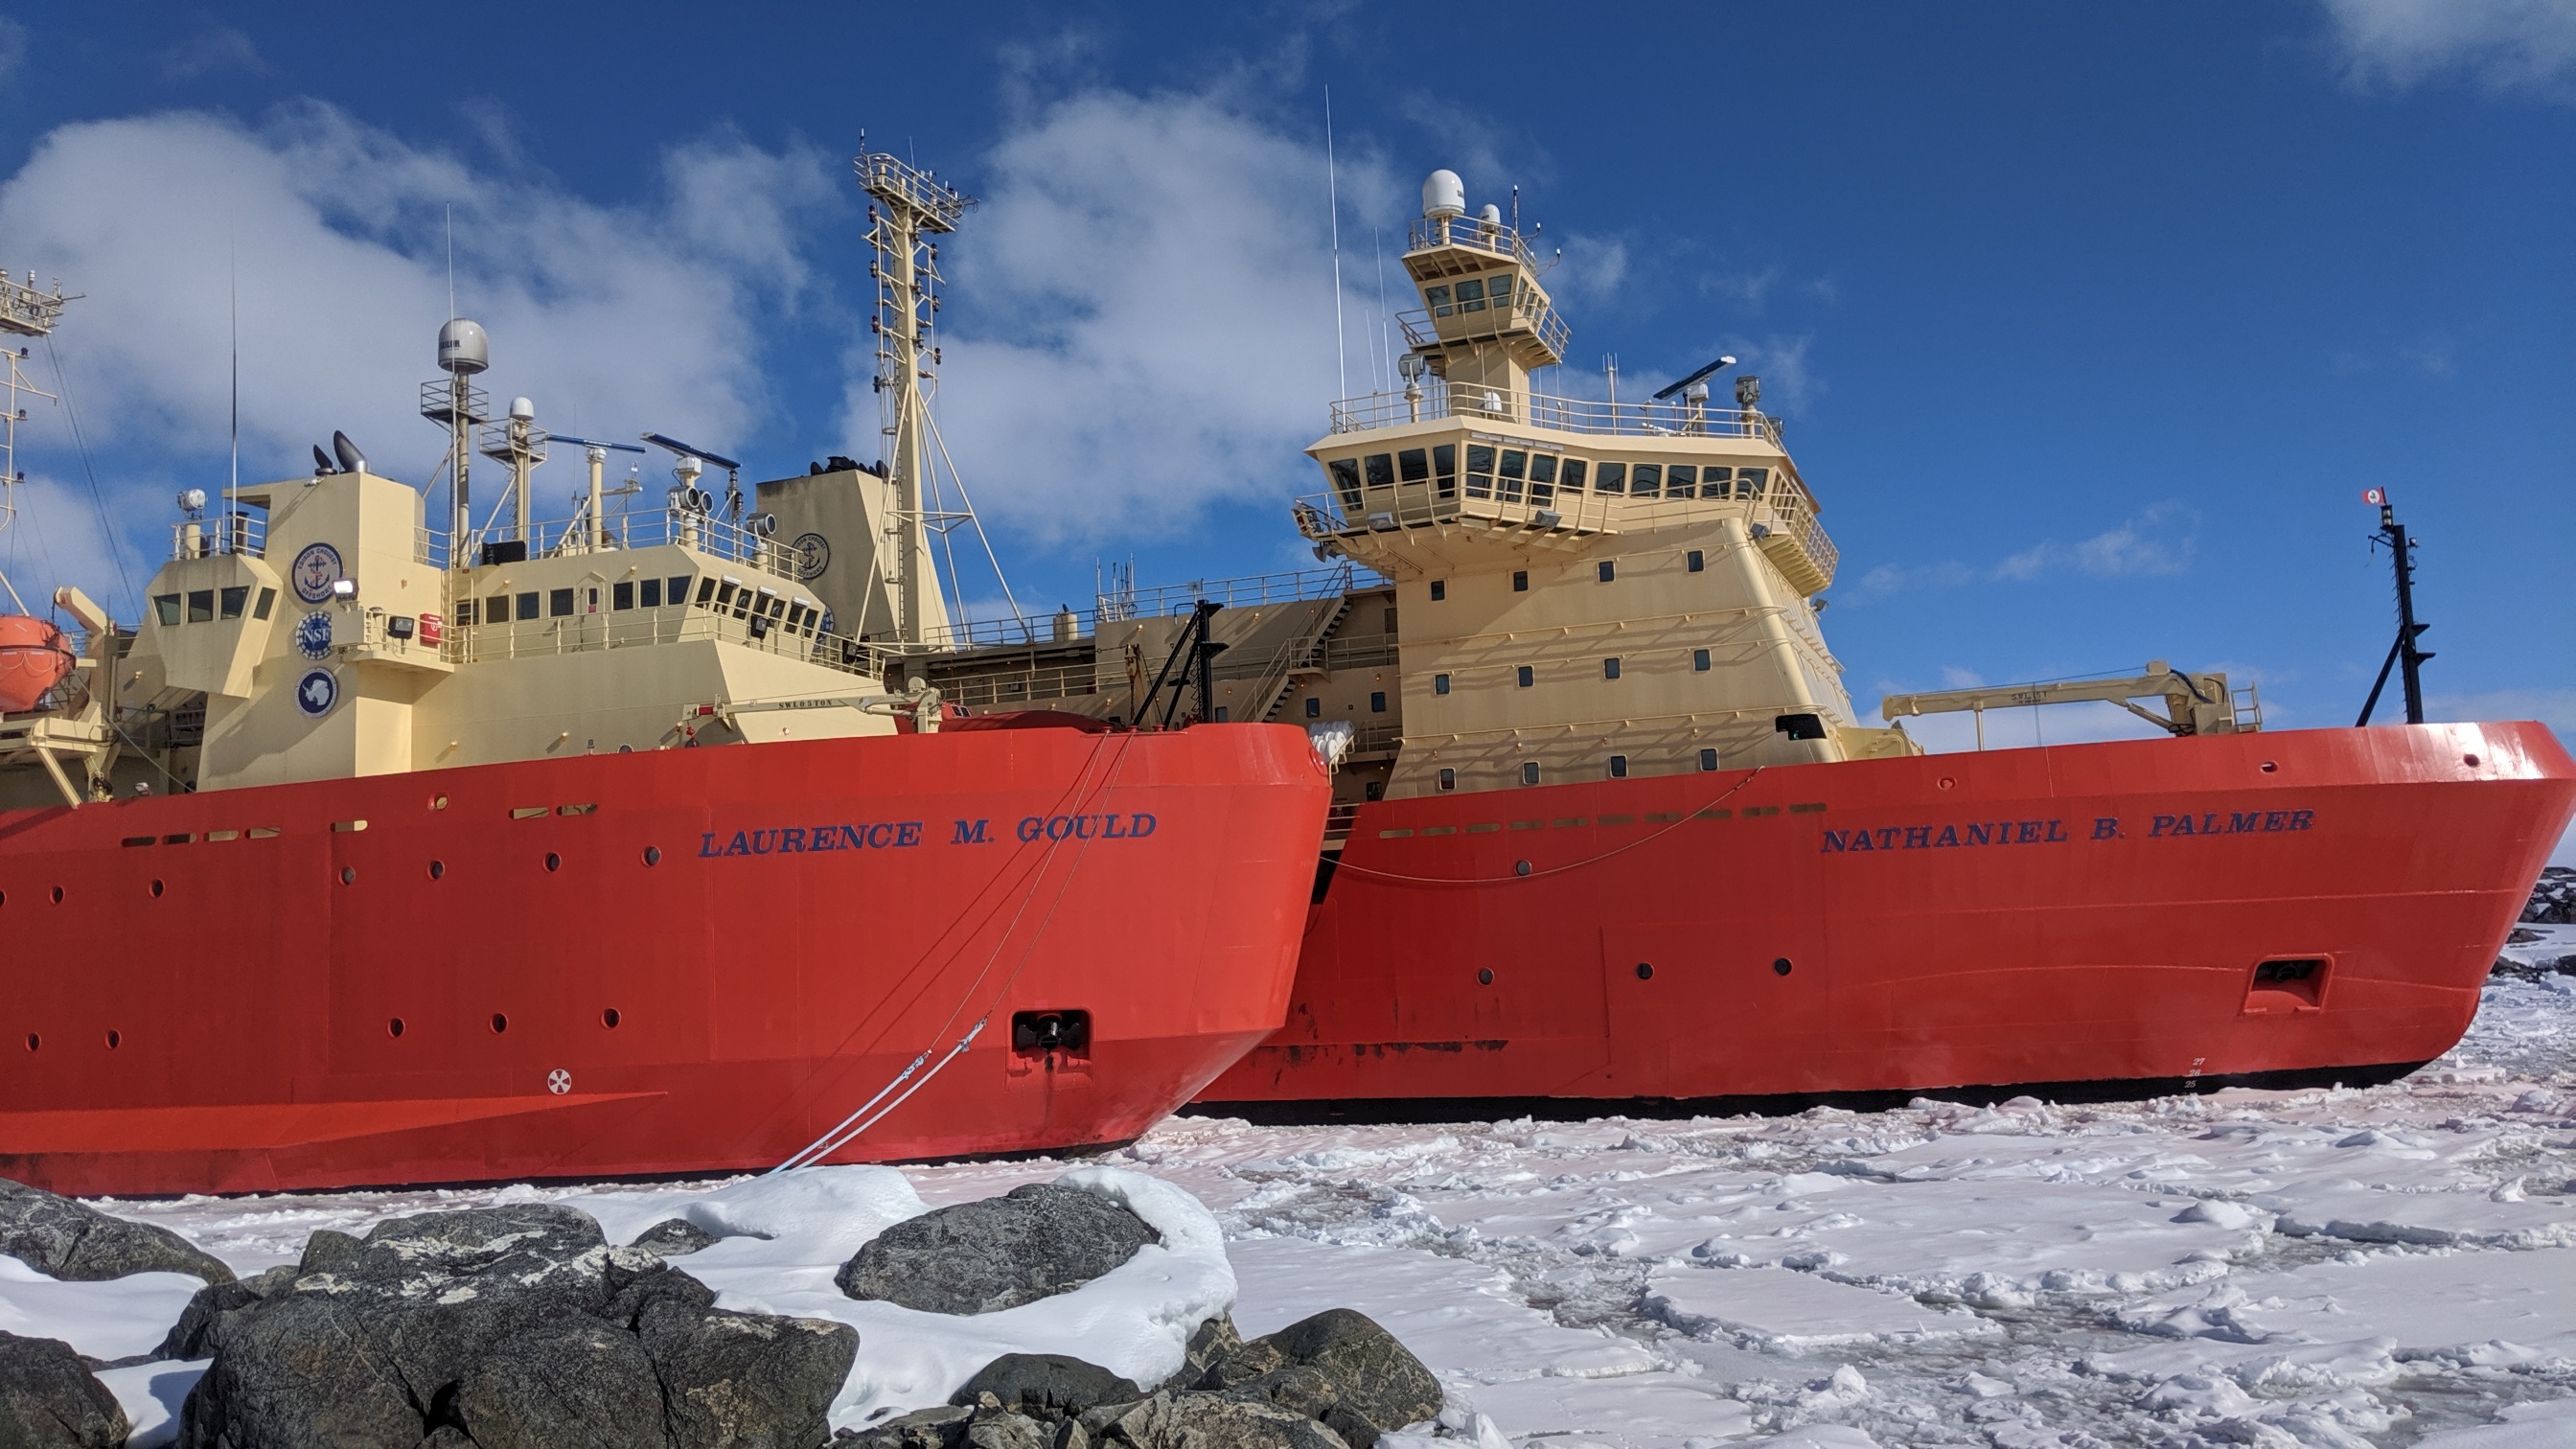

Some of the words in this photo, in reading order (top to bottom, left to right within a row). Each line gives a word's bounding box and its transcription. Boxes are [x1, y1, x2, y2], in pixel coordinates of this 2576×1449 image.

[298, 550, 314, 569] EDISON
[316, 548, 336, 564] CHOUEST
[304, 628, 331, 643] NSF
[699, 821, 923, 857] LAURENCE
[951, 819, 995, 844] M.
[1017, 814, 1157, 842] GOULD
[1822, 819, 2068, 852] NATHANIEL
[2090, 816, 2126, 840] B.
[2149, 809, 2314, 838] PALMER
